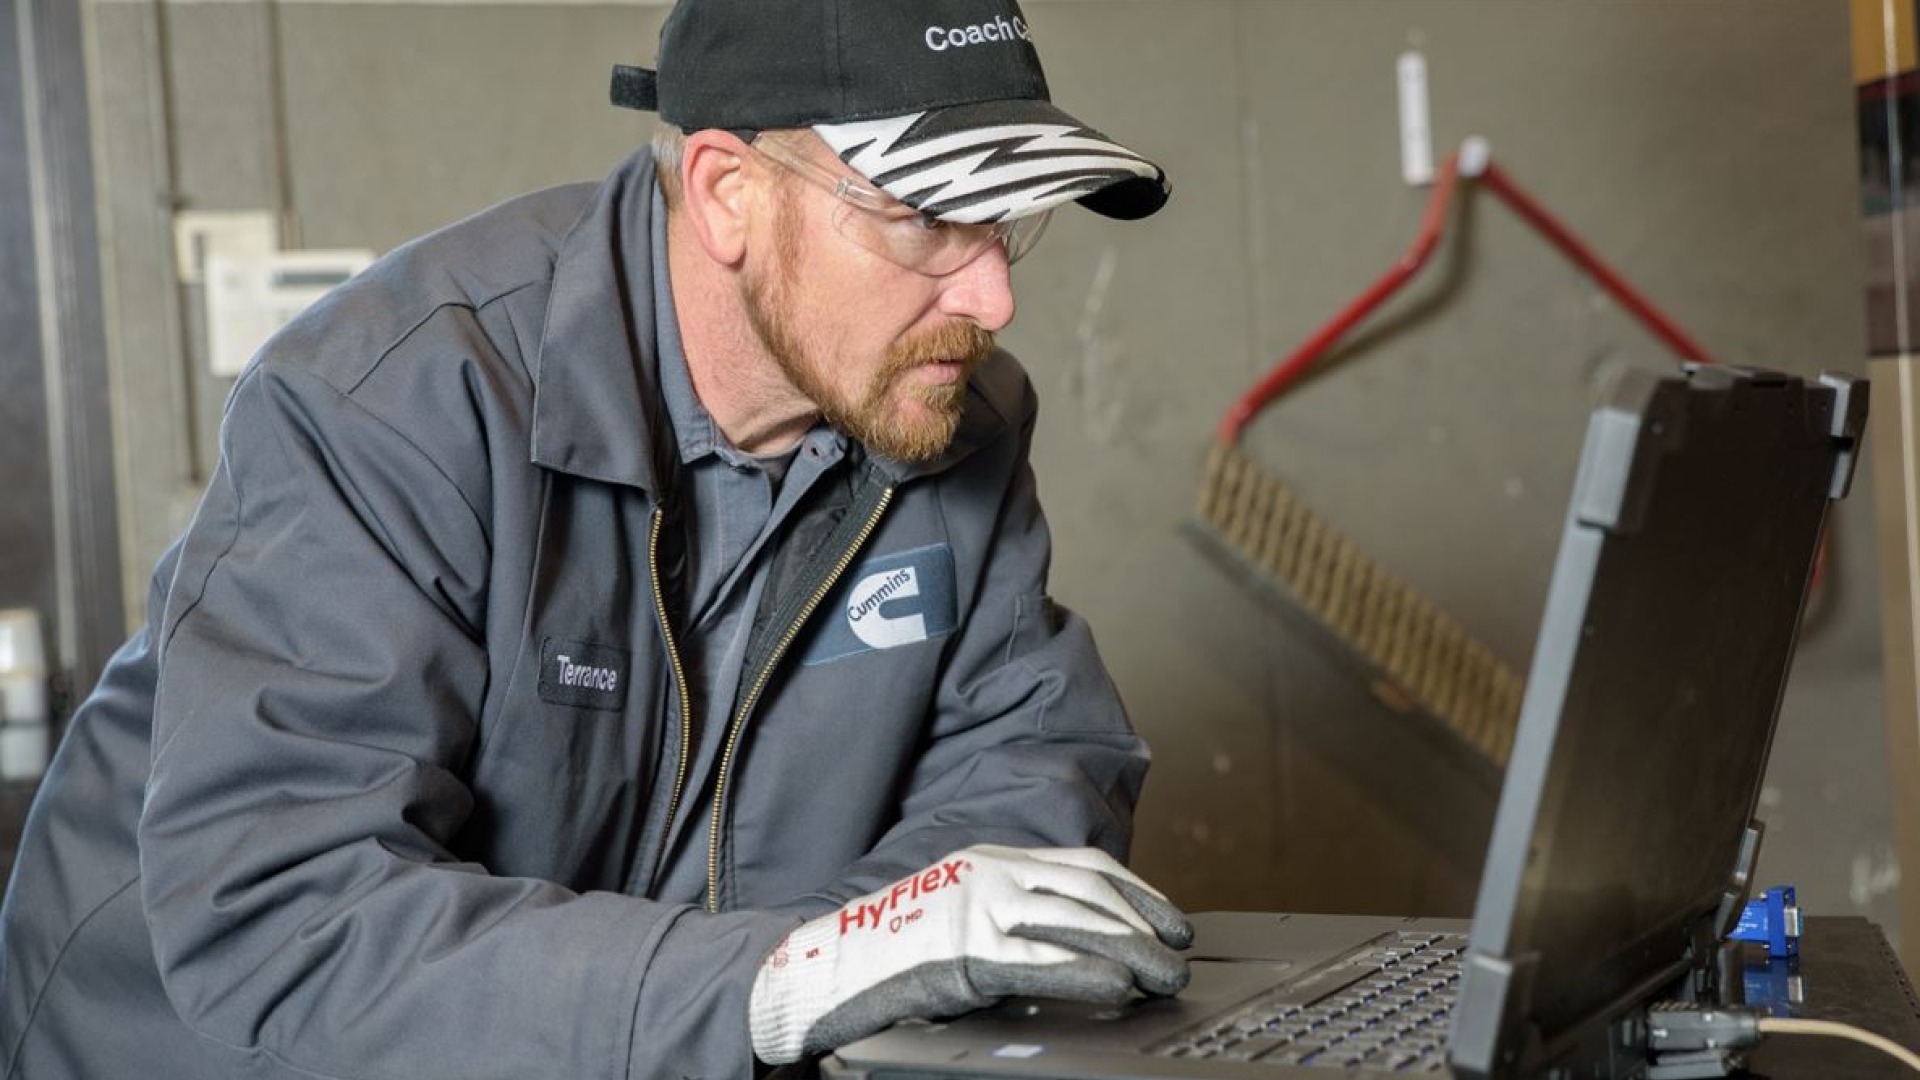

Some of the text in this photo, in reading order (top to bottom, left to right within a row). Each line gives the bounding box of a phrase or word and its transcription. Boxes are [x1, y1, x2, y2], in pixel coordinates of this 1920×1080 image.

[925, 15, 1030, 51] Coach C
[848, 568, 911, 622] Cummins
[557, 654, 617, 692] Terrance
